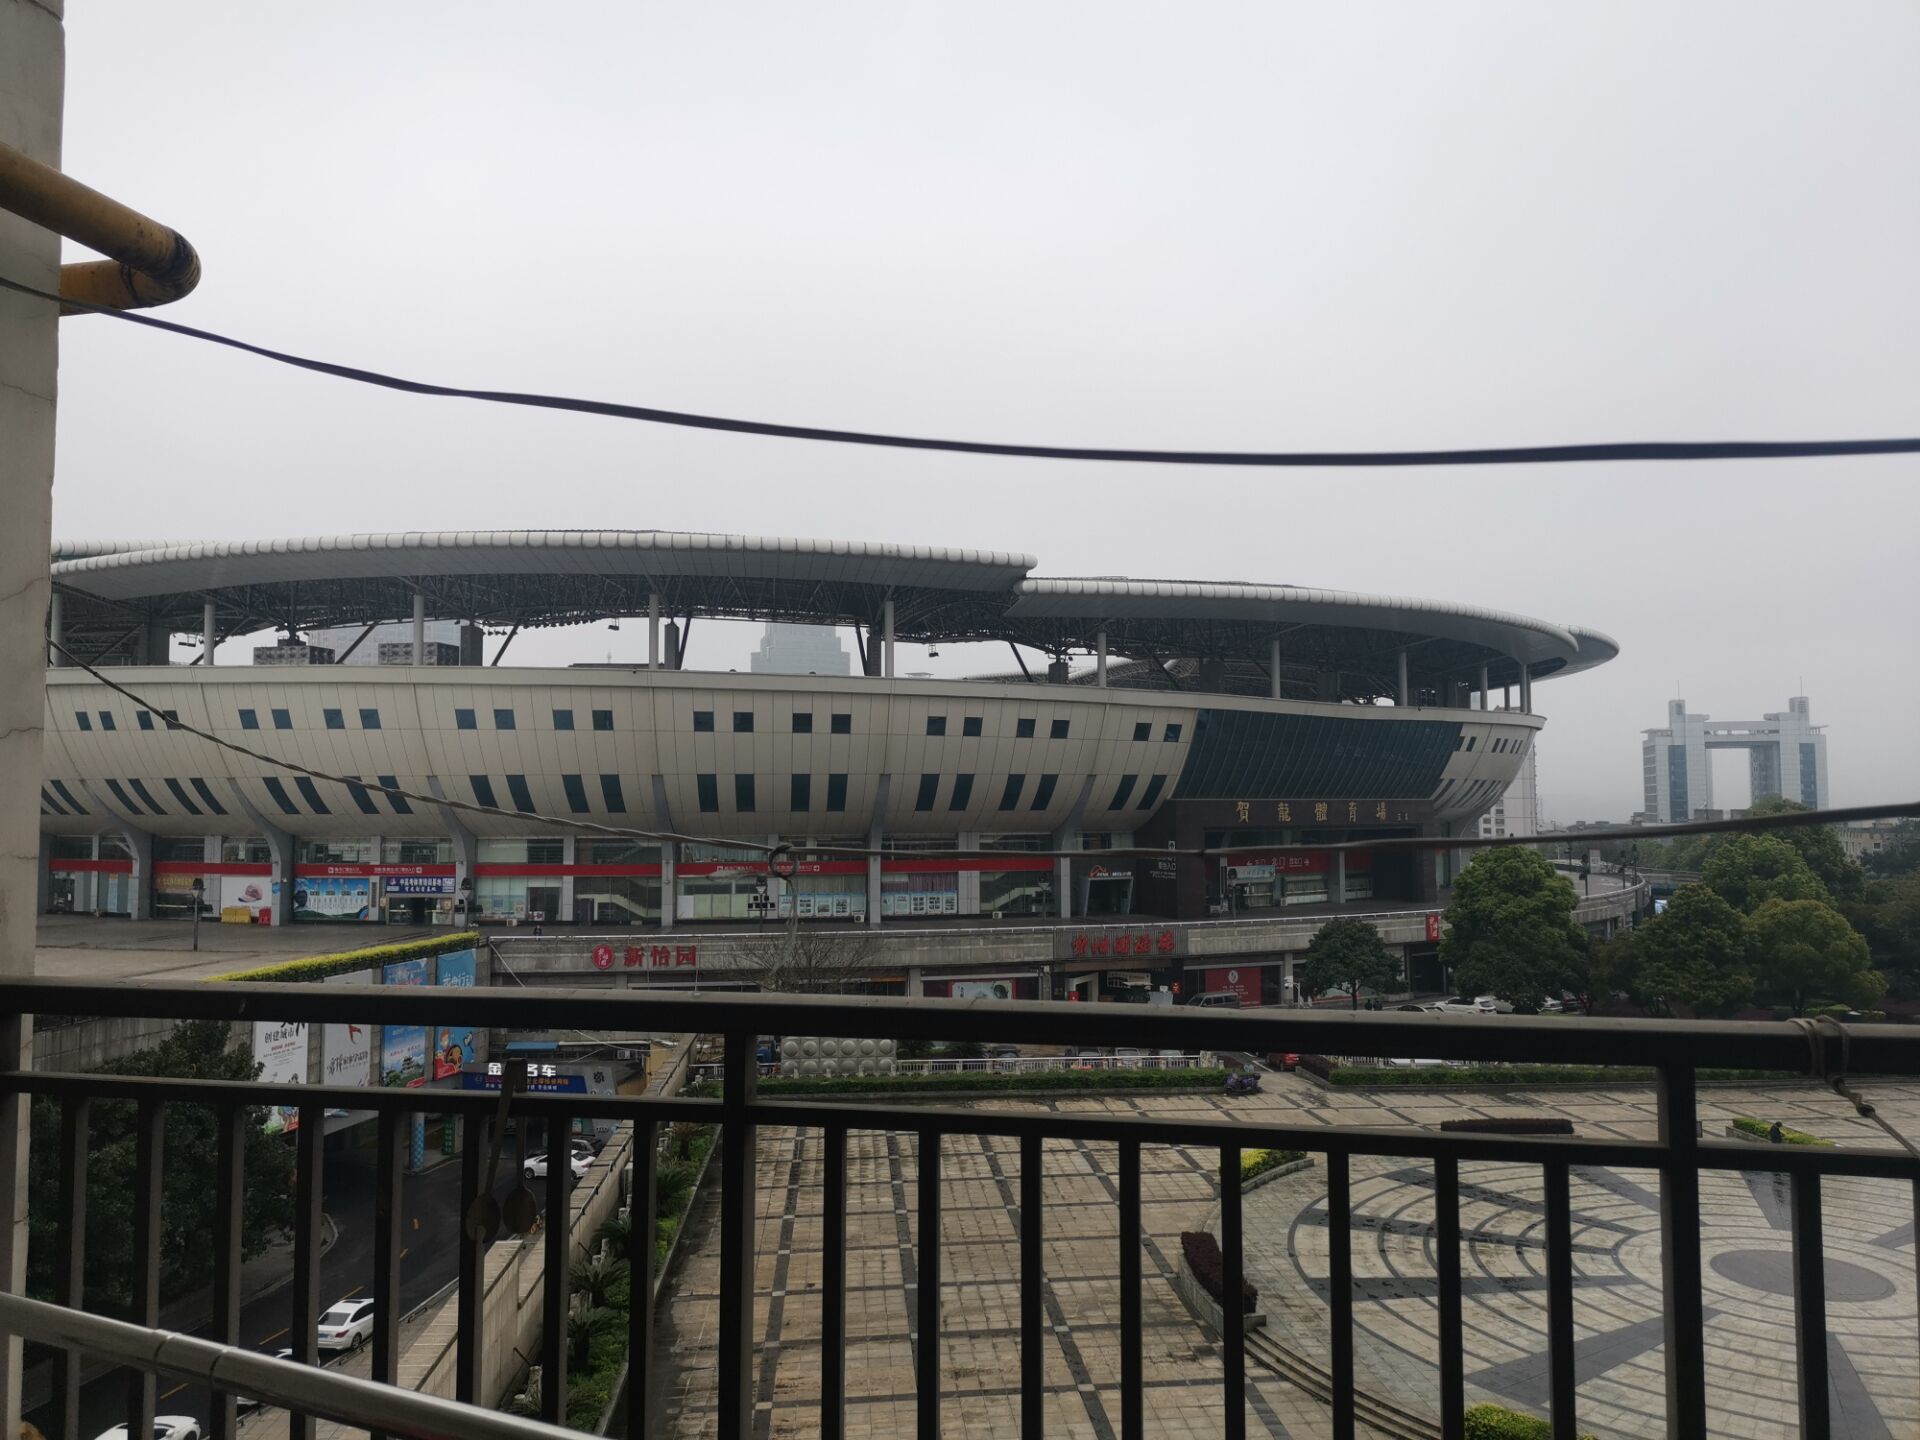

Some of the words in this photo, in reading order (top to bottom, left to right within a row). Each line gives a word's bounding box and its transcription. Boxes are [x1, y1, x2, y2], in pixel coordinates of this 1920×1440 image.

[1235, 800, 1390, 823] 賀龍體育場
[624, 945, 697, 967] 新怡园
